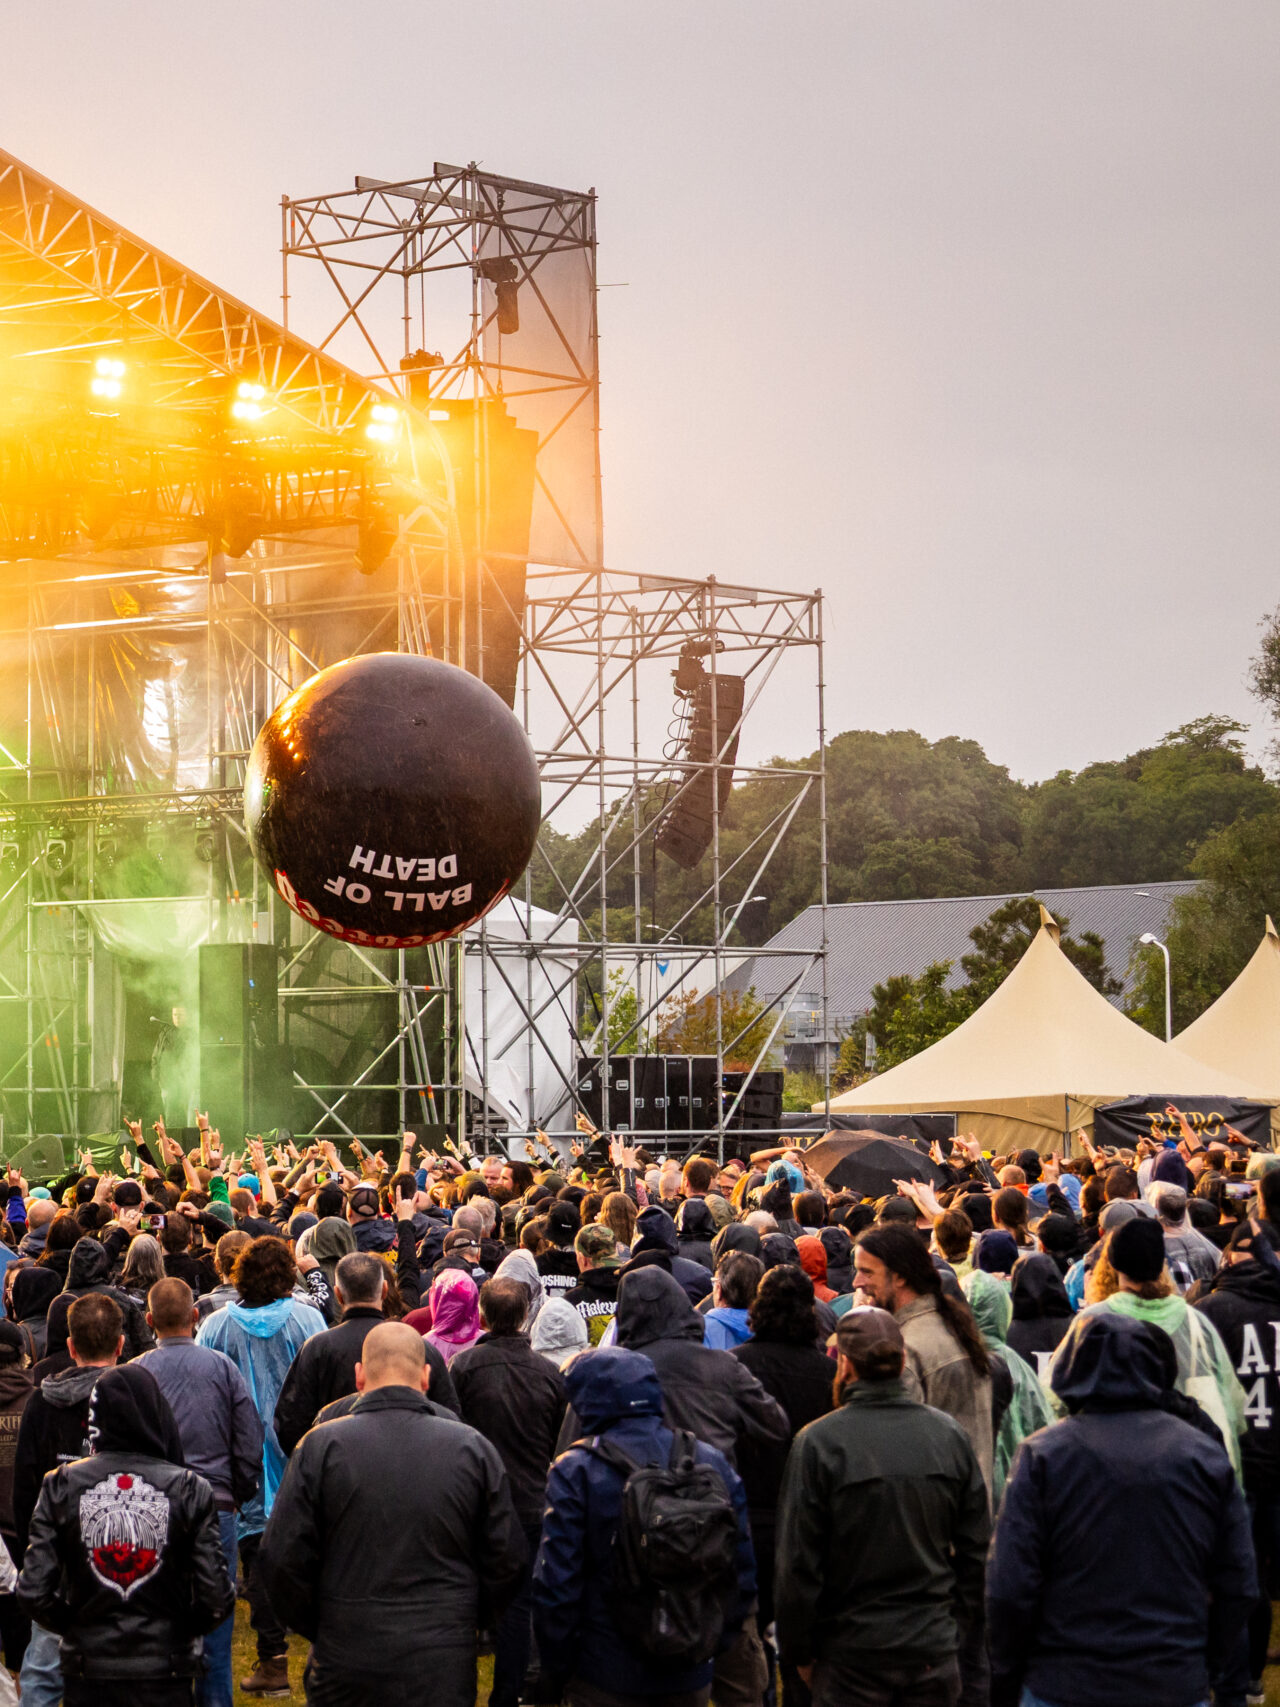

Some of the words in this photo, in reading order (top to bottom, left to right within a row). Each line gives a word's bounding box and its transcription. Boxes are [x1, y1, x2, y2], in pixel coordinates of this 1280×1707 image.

[348, 844, 458, 882] DEATH
[323, 875, 371, 904] OF
[384, 882, 473, 912] BALL
[537, 1274, 577, 1288] OSHING
